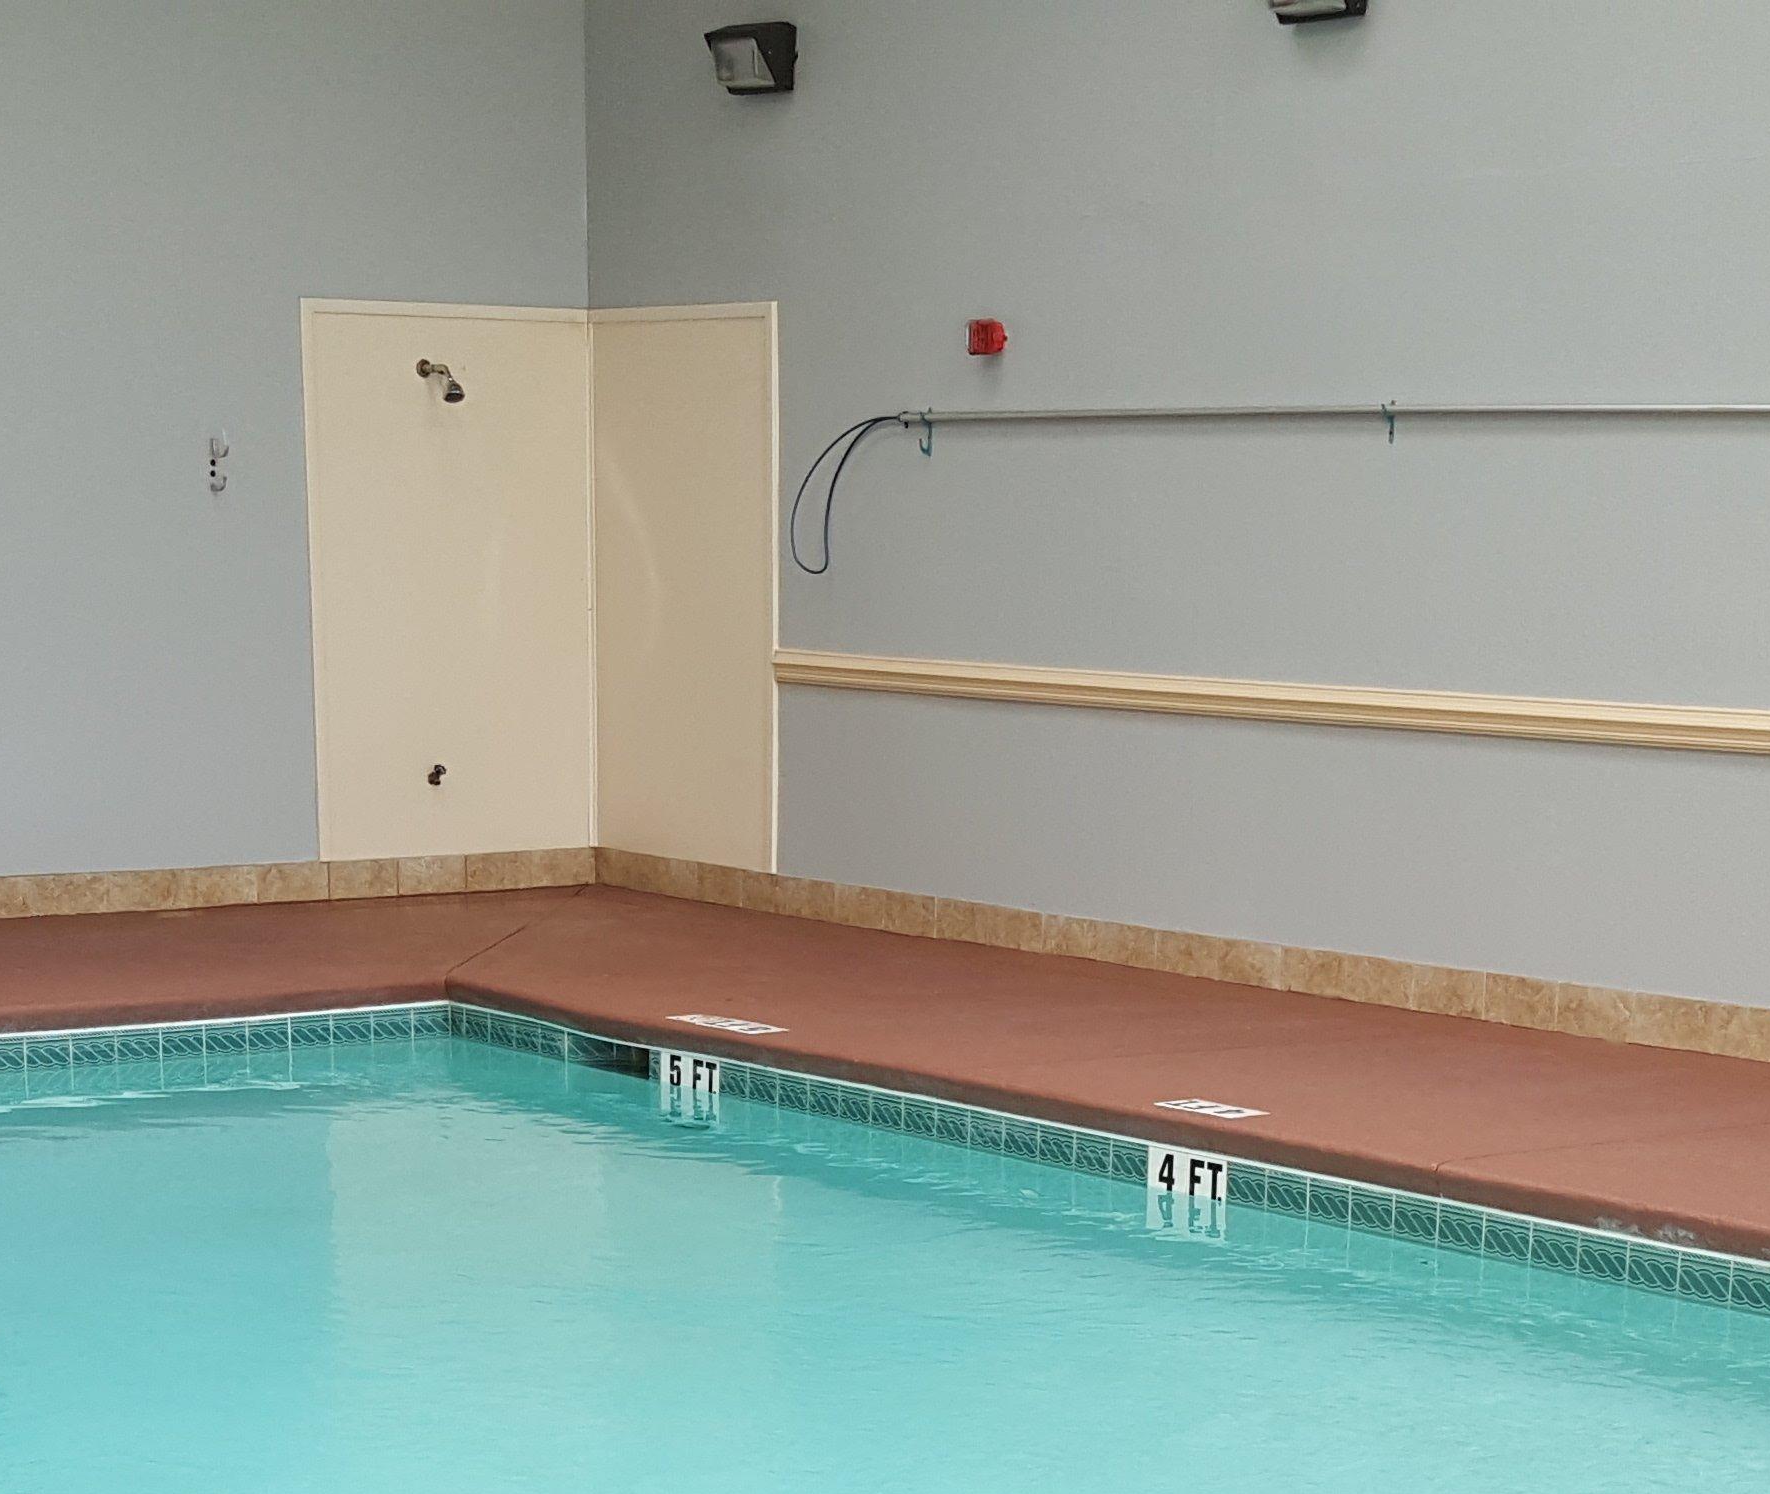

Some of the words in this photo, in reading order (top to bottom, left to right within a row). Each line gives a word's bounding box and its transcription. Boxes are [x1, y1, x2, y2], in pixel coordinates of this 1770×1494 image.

[669, 1054, 681, 1086] 5
[692, 1058, 717, 1094] FT.
[1158, 1154, 1175, 1192] 4
[1189, 1158, 1223, 1202] FT.
